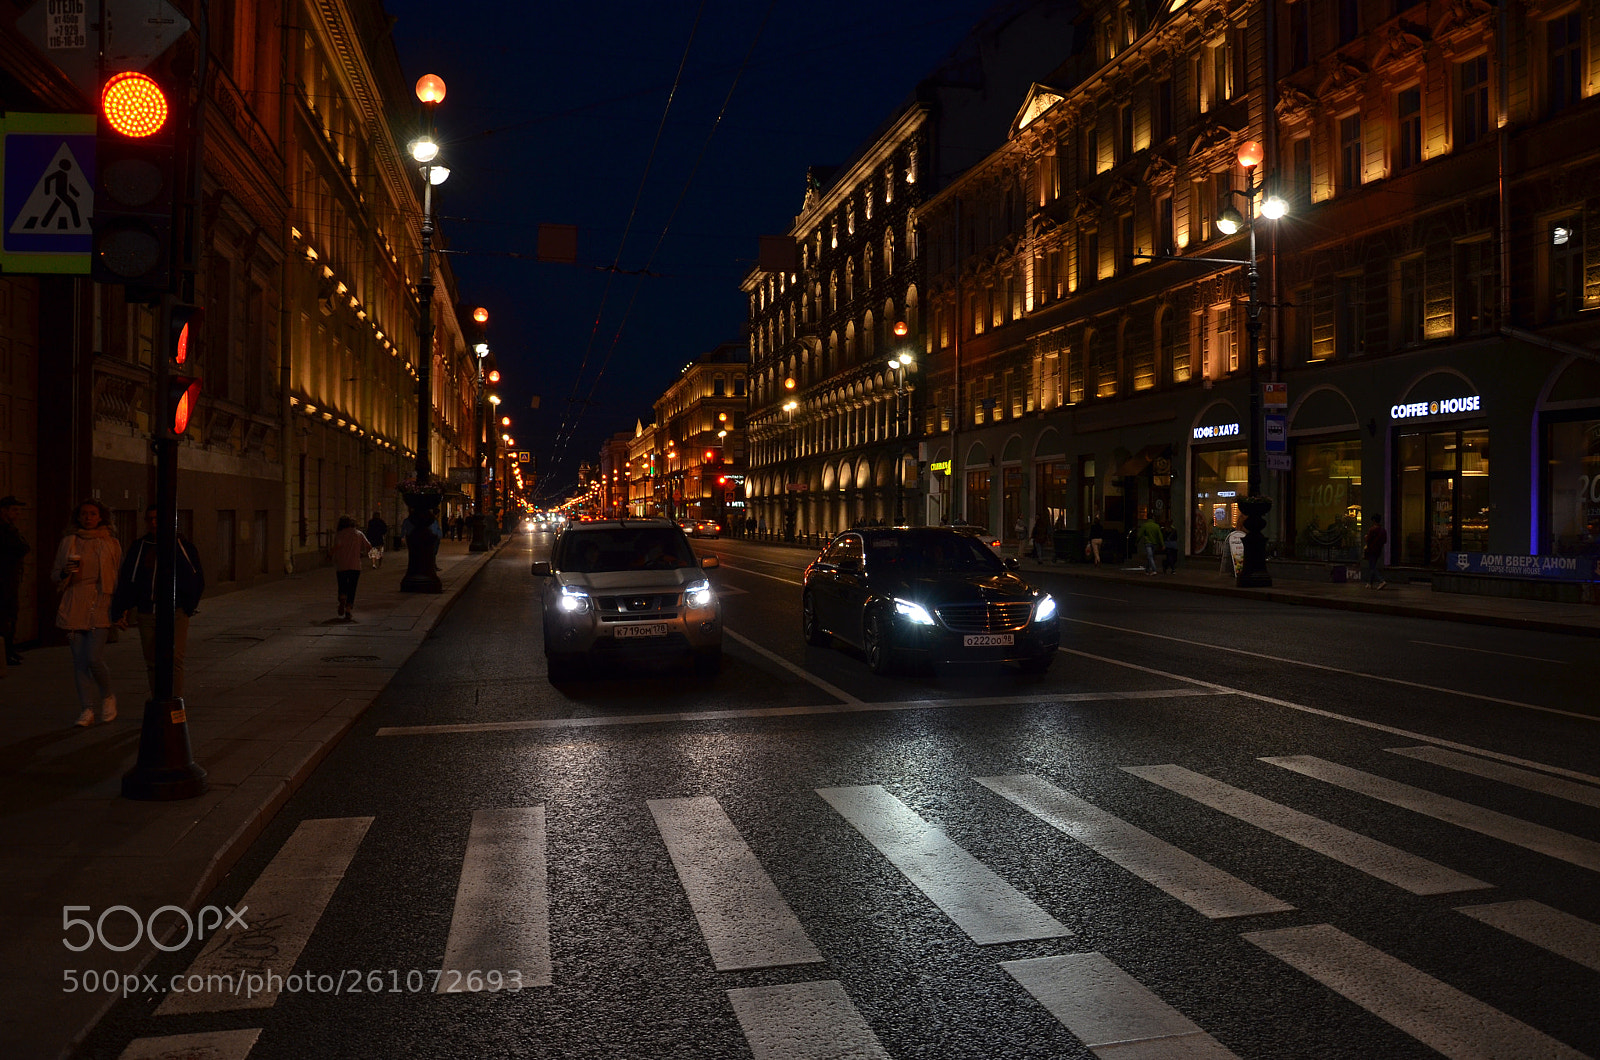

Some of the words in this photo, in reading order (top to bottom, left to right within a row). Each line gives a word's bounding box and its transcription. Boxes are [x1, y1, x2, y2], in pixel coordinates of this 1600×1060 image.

[49, 0, 83, 14] ОТЕЛЬ
[1390, 401, 1428, 419] COFFEE
[1440, 395, 1480, 414] HOUSE
[1193, 426, 1213, 439] КОФЕ
[1219, 422, 1239, 436] ХАУЗ
[1480, 554, 1503, 567] ДОМ
[1505, 556, 1540, 568] ВВЕРХ
[1542, 557, 1577, 570] ДНОМ
